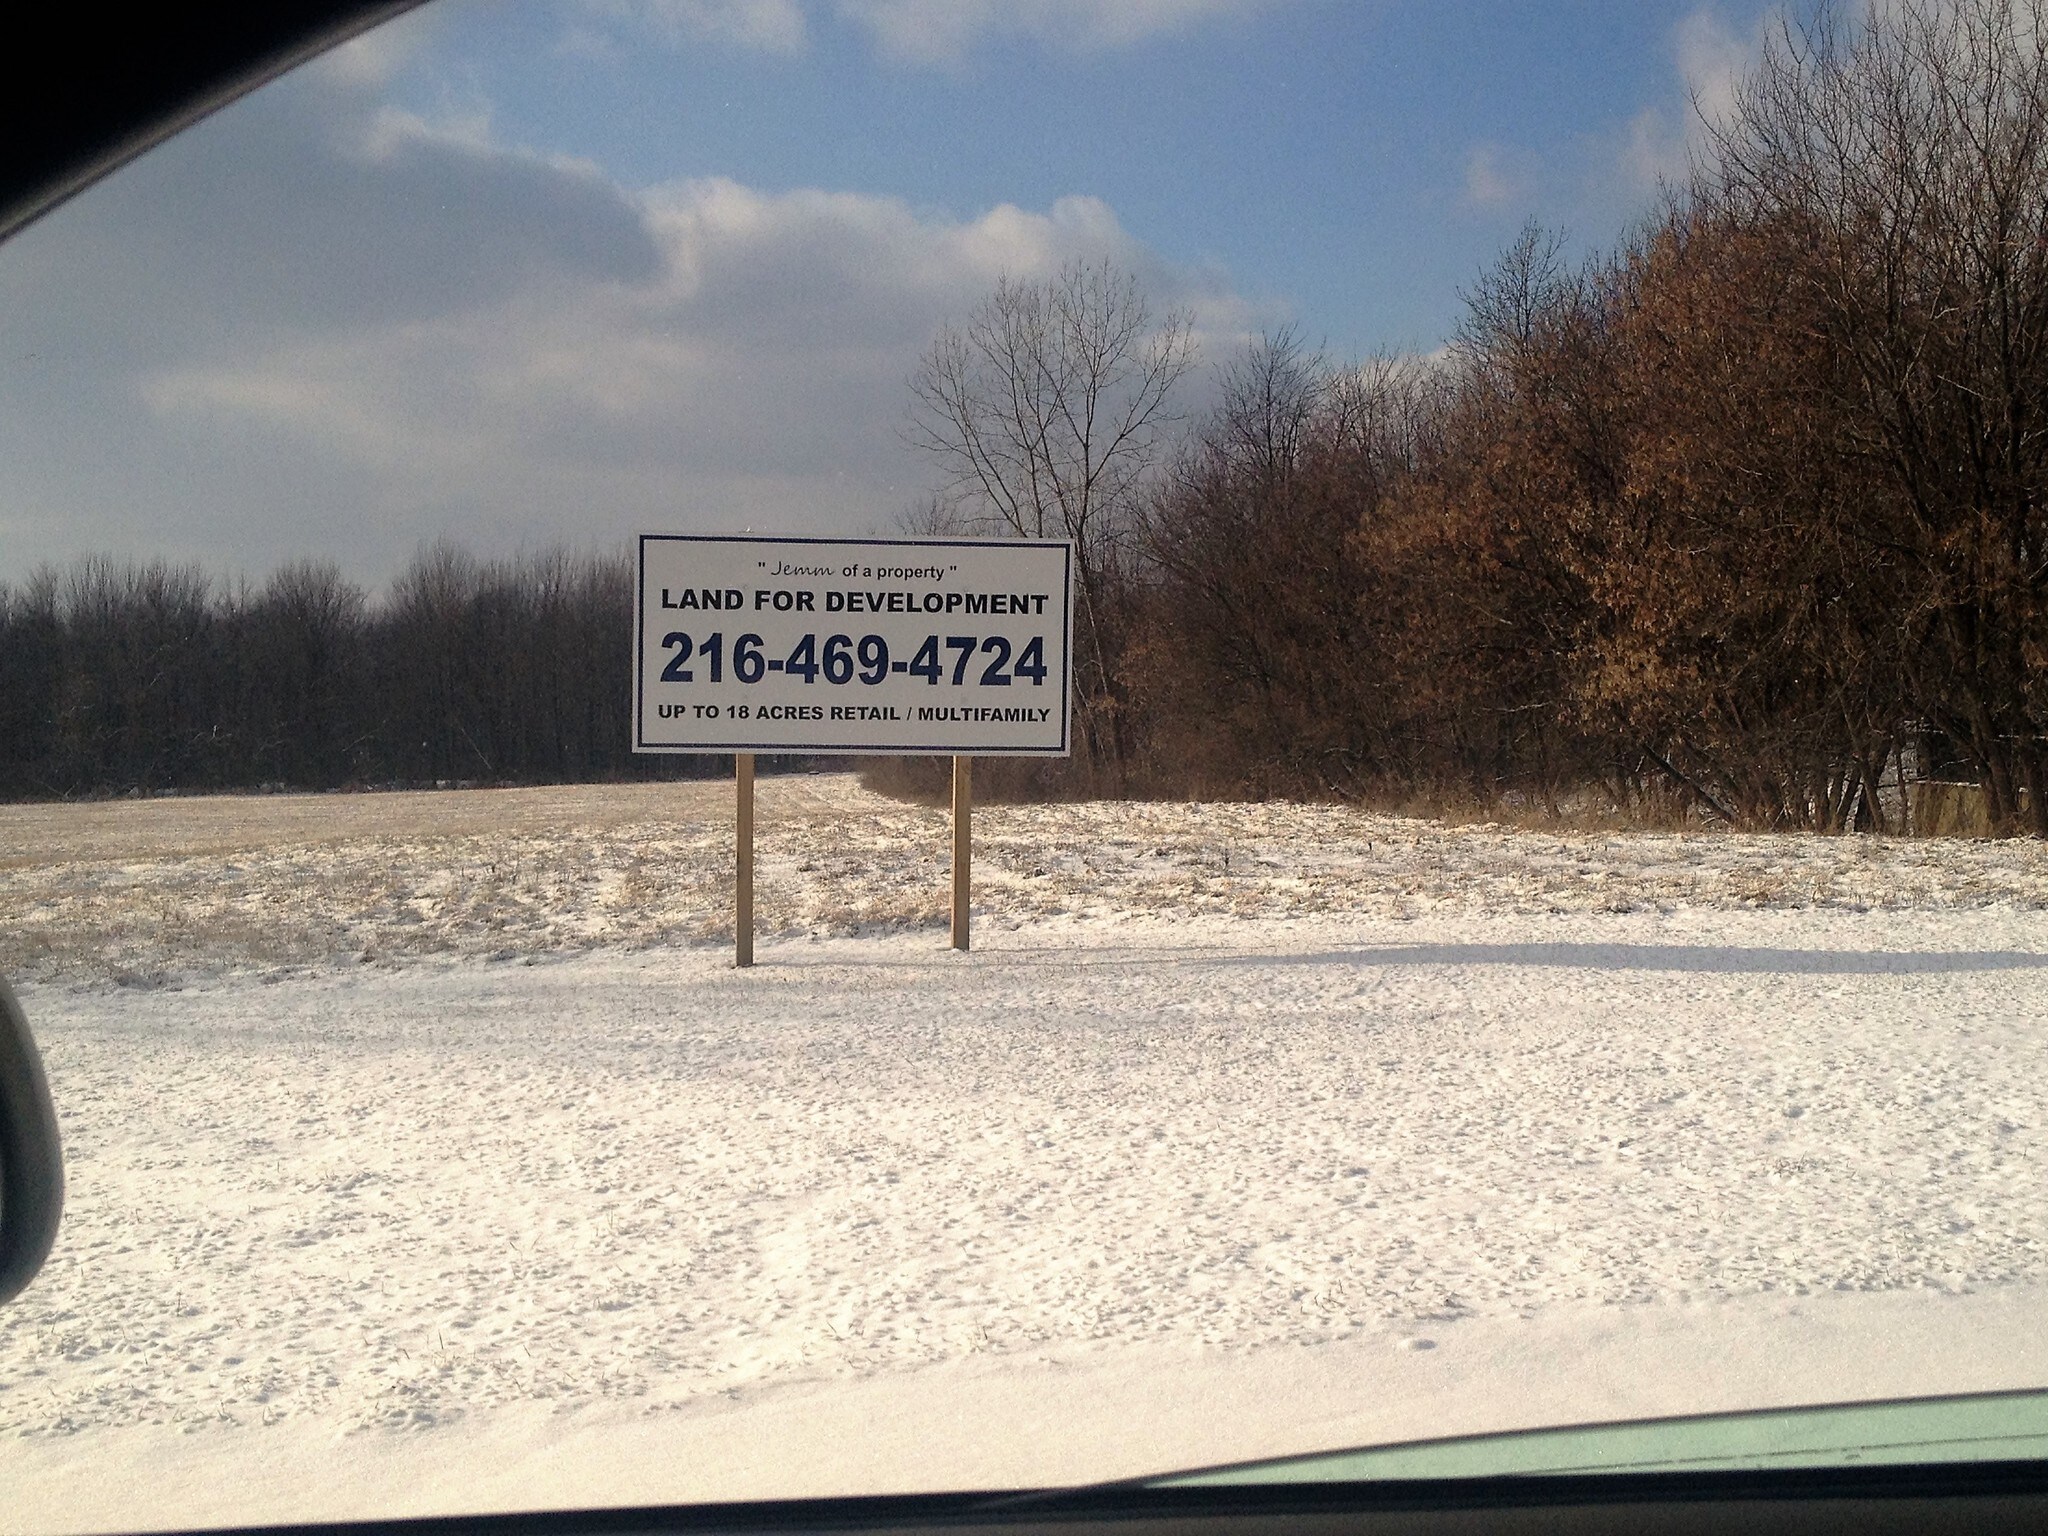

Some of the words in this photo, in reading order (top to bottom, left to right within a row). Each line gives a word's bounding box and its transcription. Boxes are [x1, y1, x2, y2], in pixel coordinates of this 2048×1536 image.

[841, 563, 859, 578] of
[862, 567, 872, 578] a
[877, 566, 944, 582] property
[662, 587, 745, 610] LAND
[755, 590, 815, 612] FOR
[826, 590, 1049, 615] DEVELOPMENT
[660, 632, 1047, 686] 216-469-4724
[657, 703, 687, 720] UP
[692, 704, 720, 720] TO
[726, 704, 750, 720] 18
[756, 706, 823, 720] ACRES
[831, 706, 901, 720] RETAIL
[918, 707, 1051, 722] MULTIFAMILY
